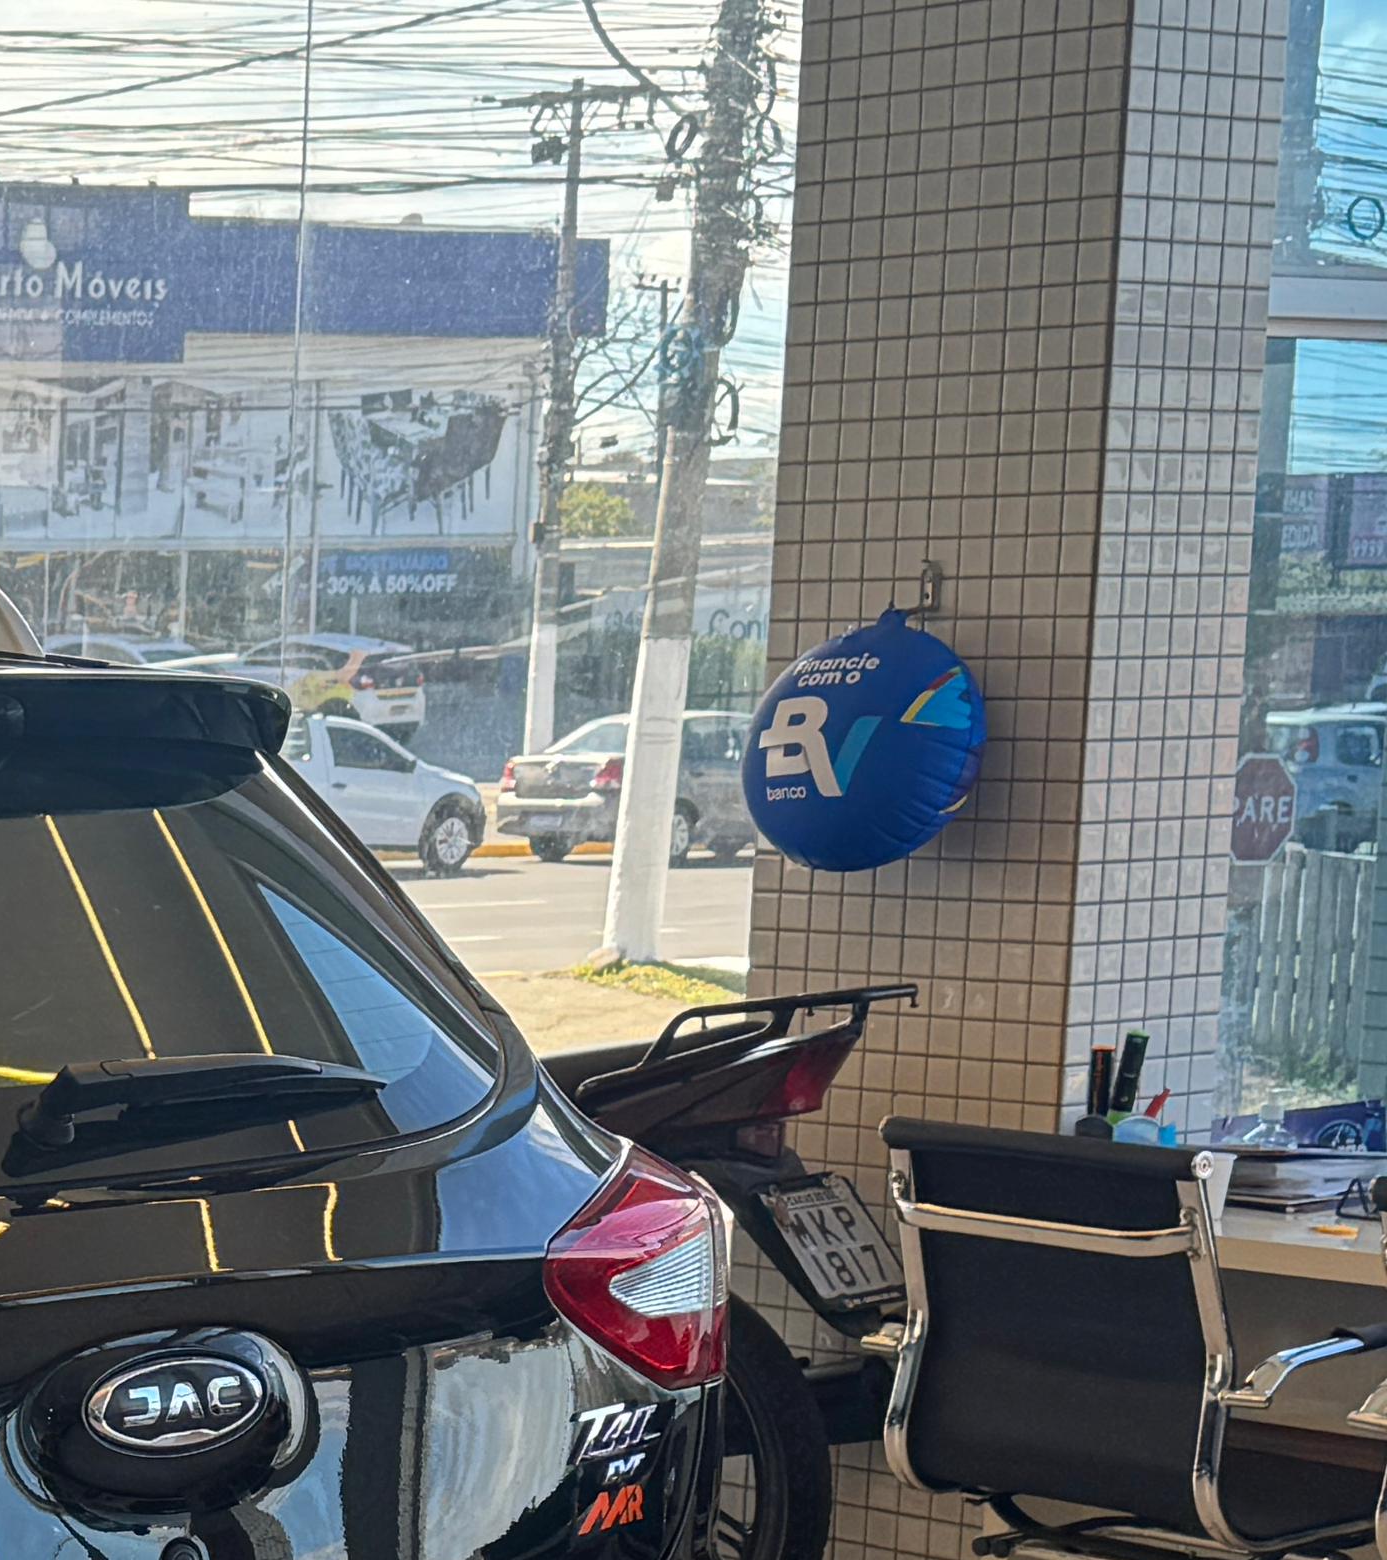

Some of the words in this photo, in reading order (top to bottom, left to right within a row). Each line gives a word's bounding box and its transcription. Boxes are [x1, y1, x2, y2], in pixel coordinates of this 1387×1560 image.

[327, 575, 365, 594] 30%
[793, 652, 880, 676] Financie
[797, 672, 842, 688] com
[845, 670, 861, 685] o
[758, 695, 883, 797] BV
[765, 786, 807, 801] banco
[810, 1244, 888, 1292] 1817
[123, 1374, 242, 1428] JAC
